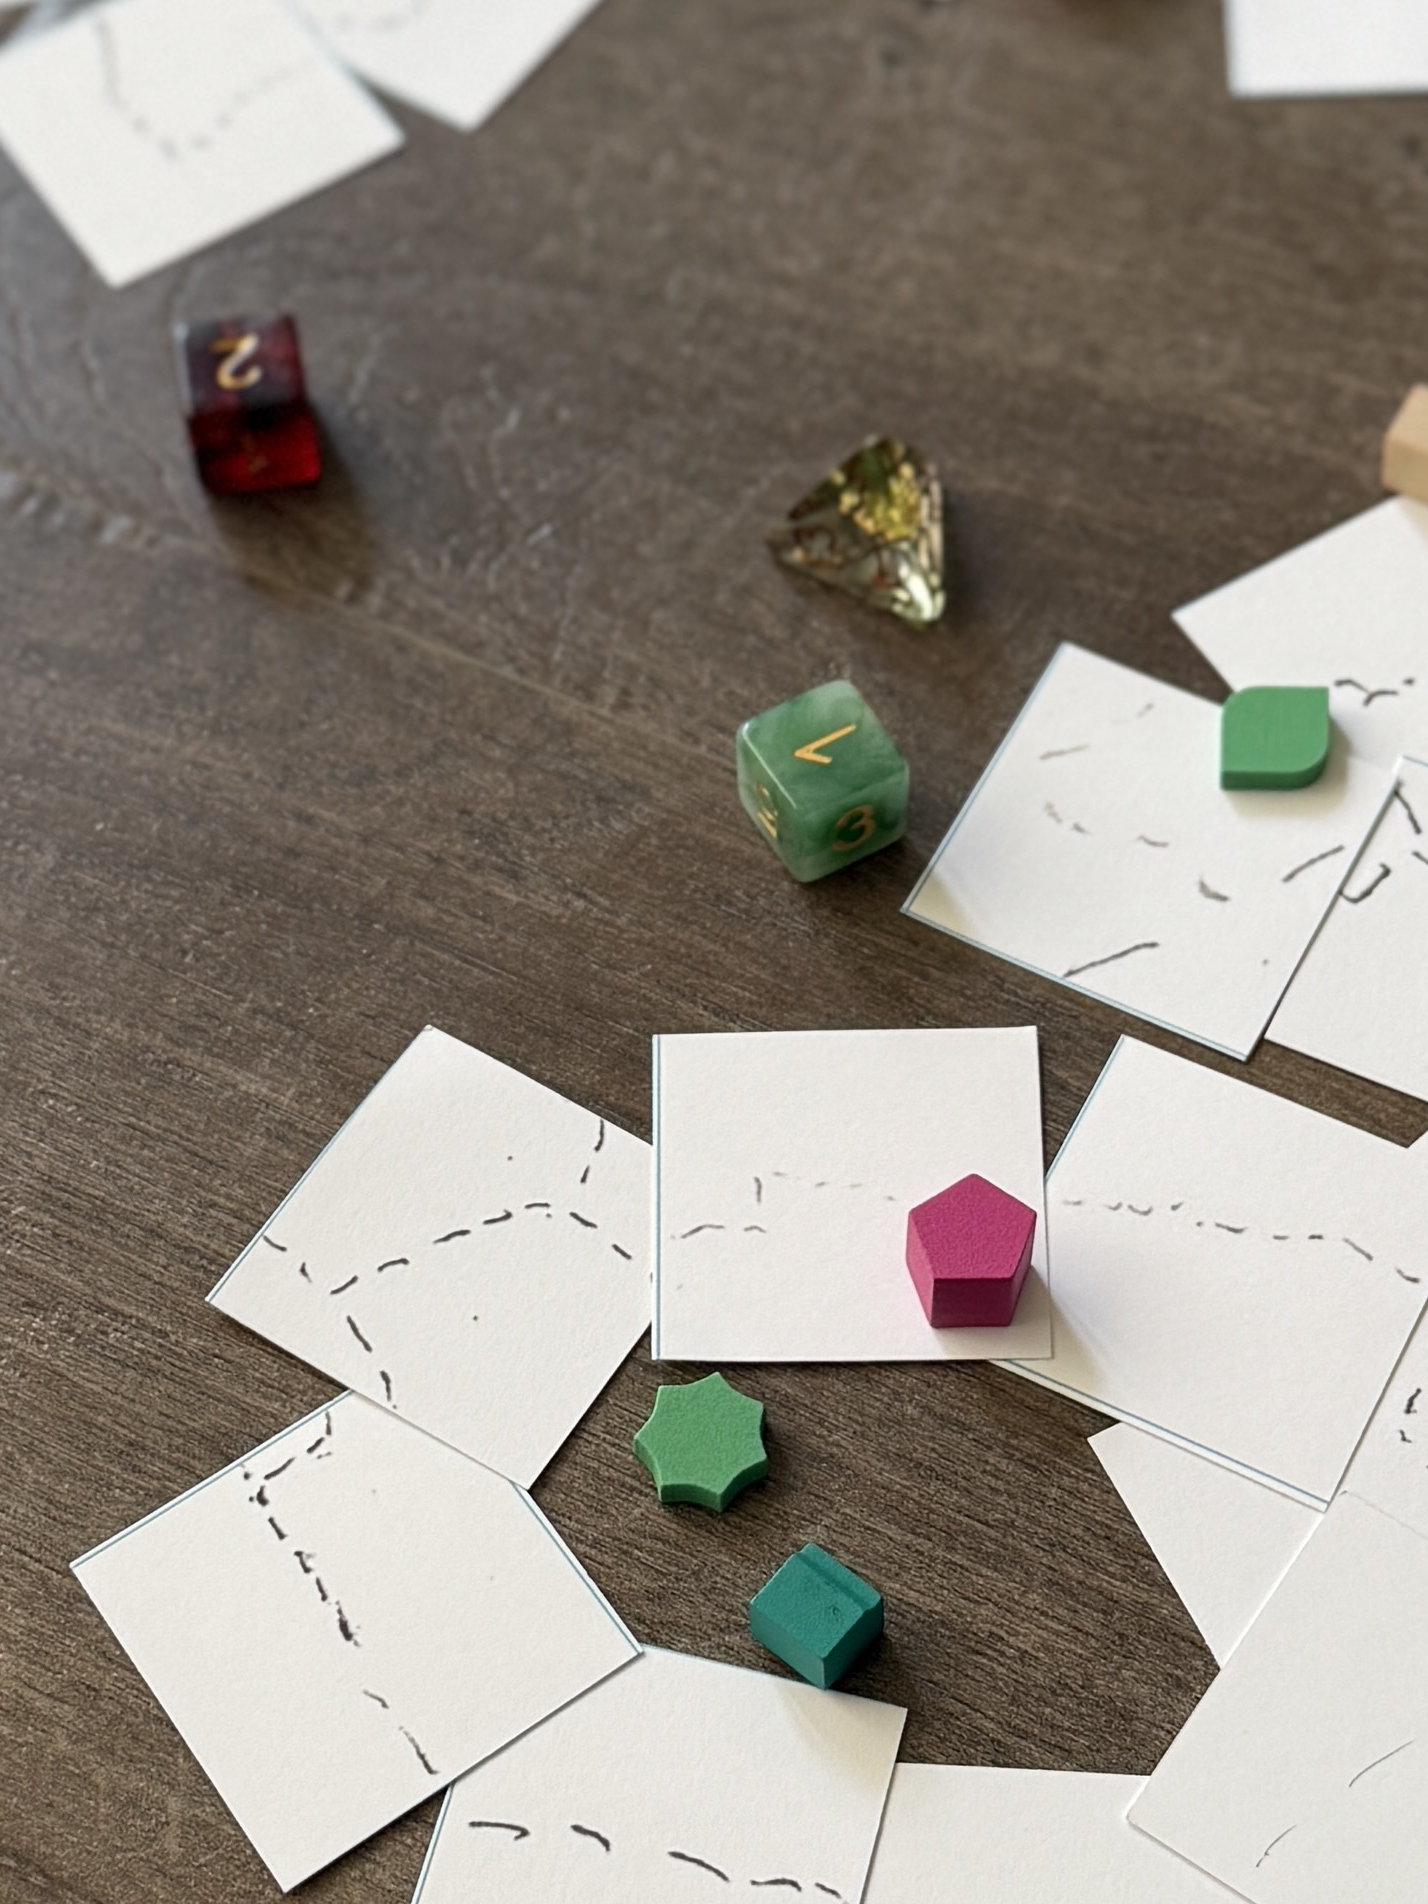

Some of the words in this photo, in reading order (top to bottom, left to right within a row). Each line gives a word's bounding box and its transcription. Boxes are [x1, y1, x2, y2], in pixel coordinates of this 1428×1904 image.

[209, 331, 263, 390] 2
[793, 723, 857, 765] 1
[831, 803, 877, 852] 3
